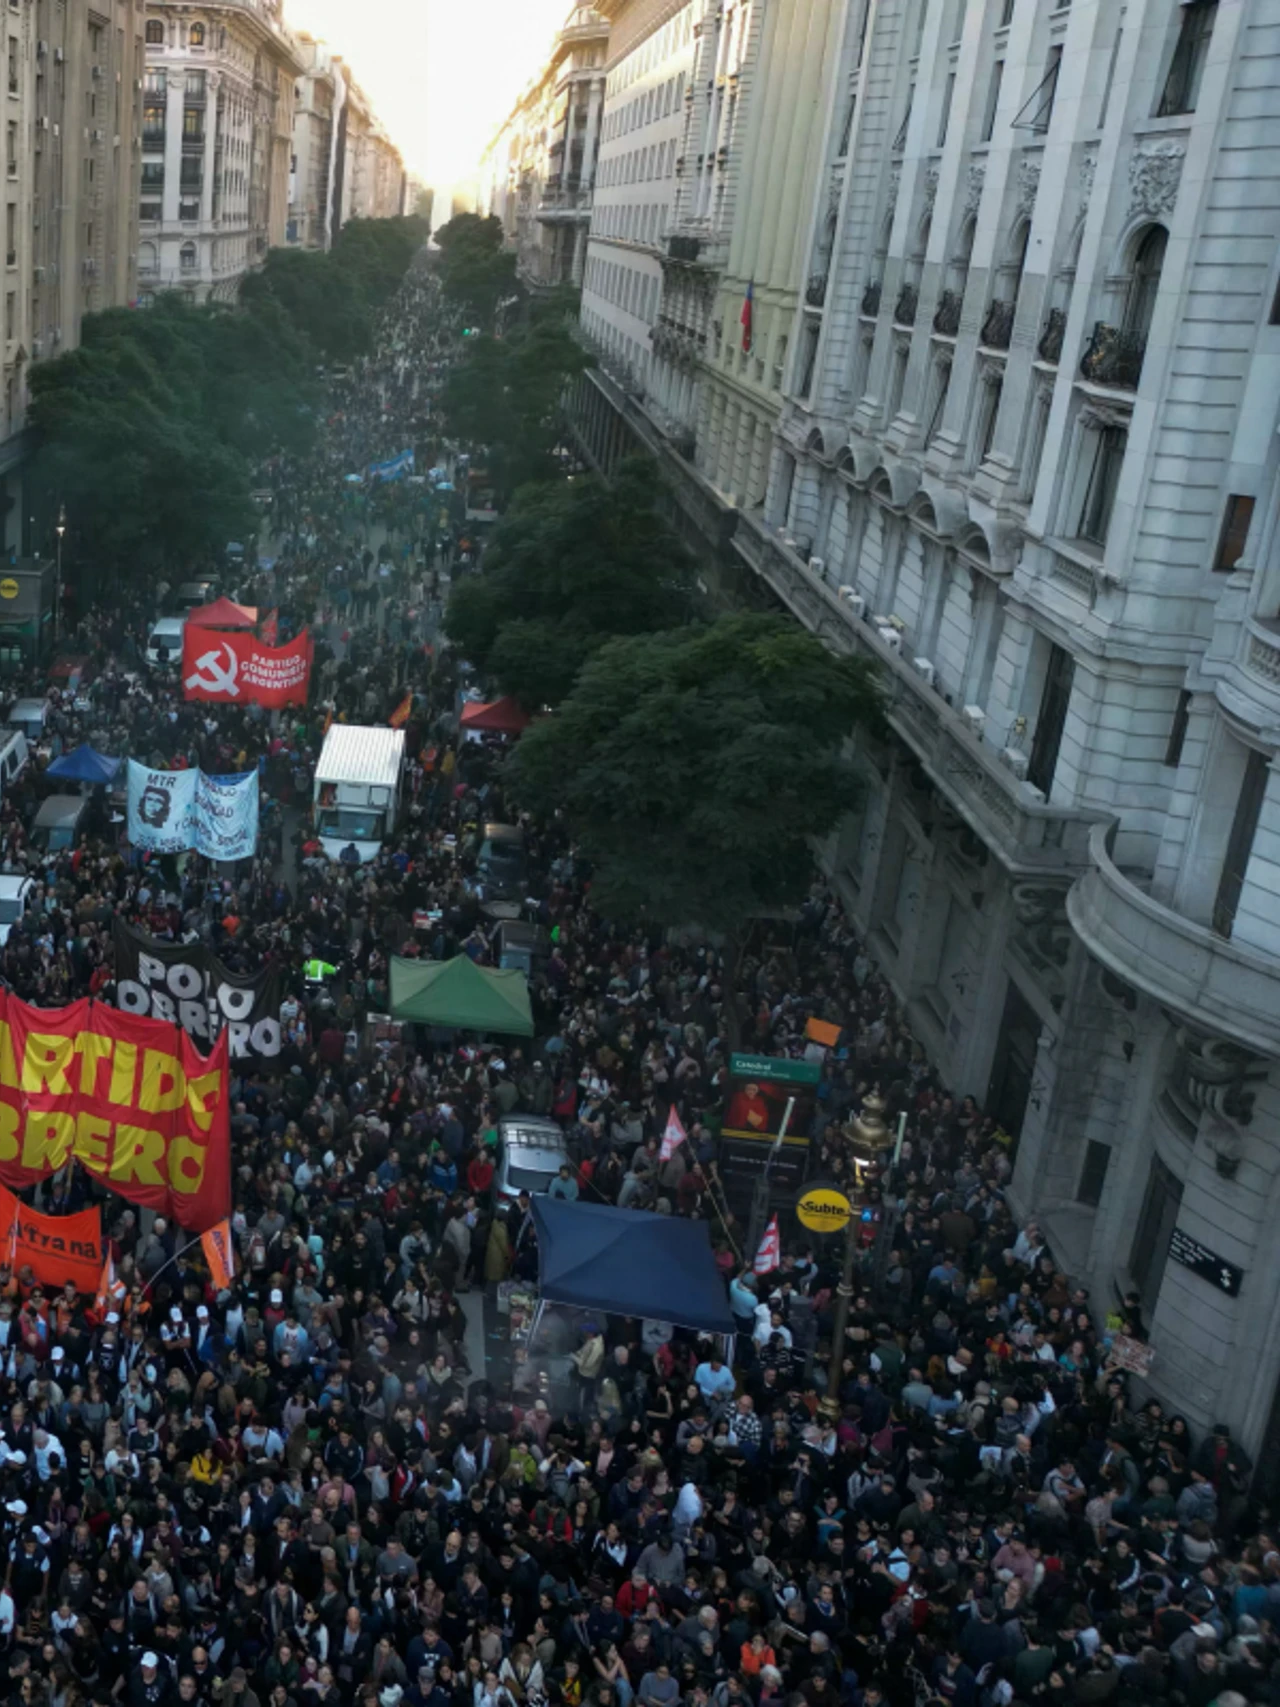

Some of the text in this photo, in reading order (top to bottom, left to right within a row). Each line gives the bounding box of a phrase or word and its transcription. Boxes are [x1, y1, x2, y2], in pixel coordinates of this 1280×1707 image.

[251, 652, 300, 668] PARTIDO
[147, 773, 177, 788] MTR
[736, 1060, 771, 1070] Catedral
[803, 1201, 845, 1215] Subte
